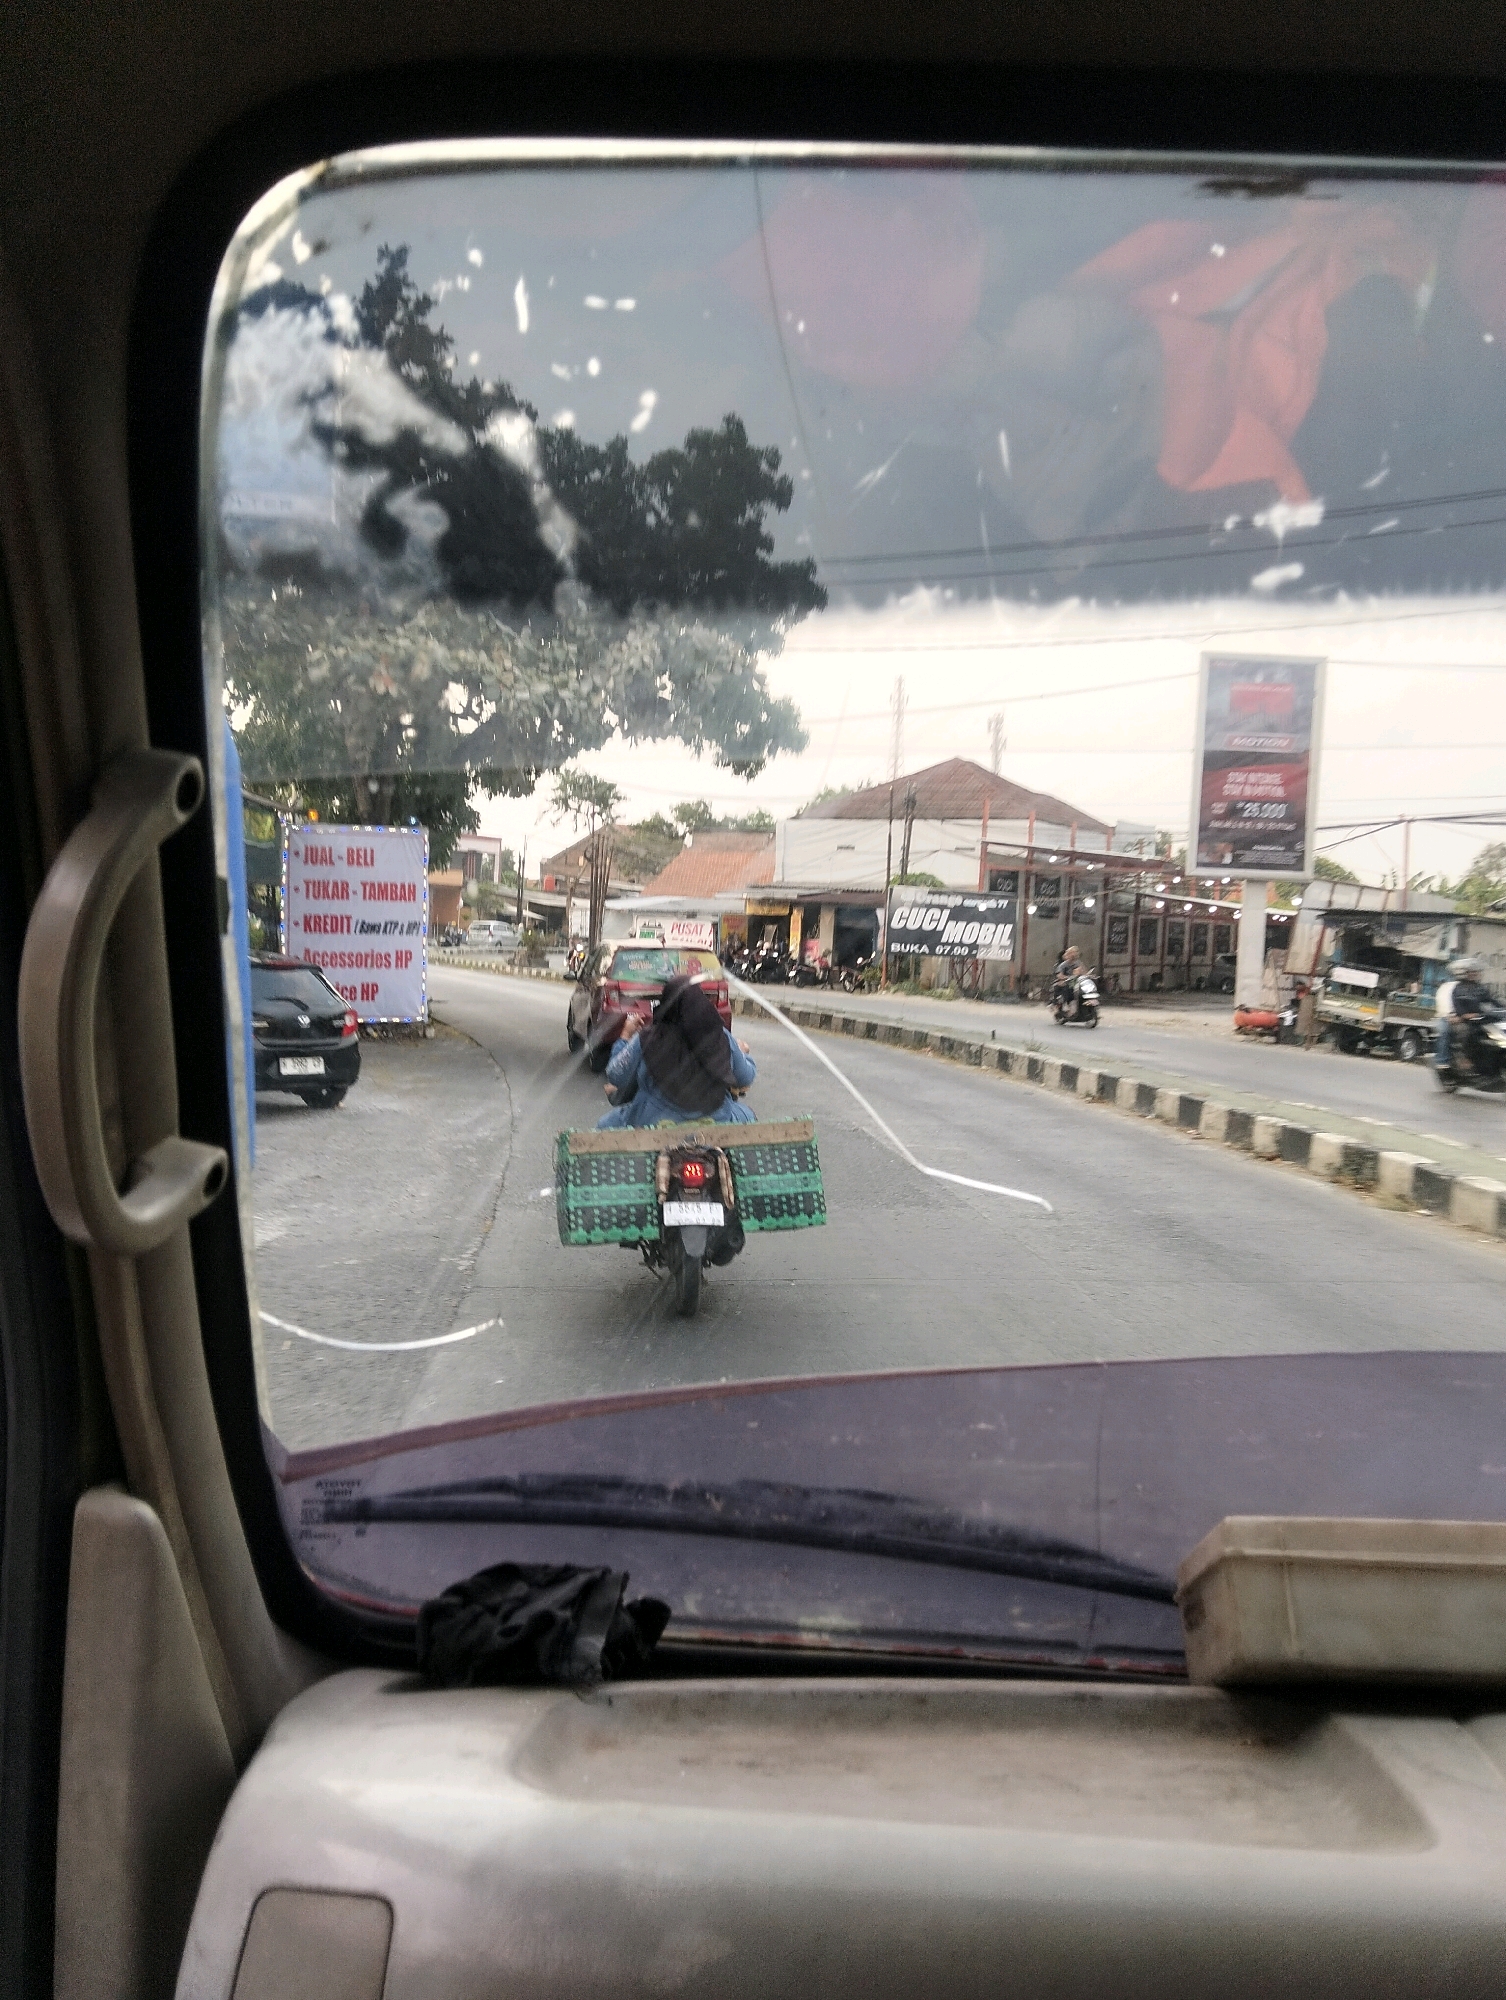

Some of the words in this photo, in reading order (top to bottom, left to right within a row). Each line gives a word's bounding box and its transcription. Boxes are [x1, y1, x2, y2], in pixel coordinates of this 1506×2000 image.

[303, 845, 335, 866] JUAL
[347, 847, 374, 867] BELI
[303, 880, 349, 900] TUKAR
[303, 914, 352, 934] KREDIT
[671, 922, 704, 935] PUSAT
[890, 907, 950, 931] CUCI
[941, 920, 1013, 946] MOBIL
[891, 942, 929, 954] BUKA
[303, 947, 391, 970] Accessories
[395, 950, 413, 969] HP
[361, 982, 379, 1002] HP
